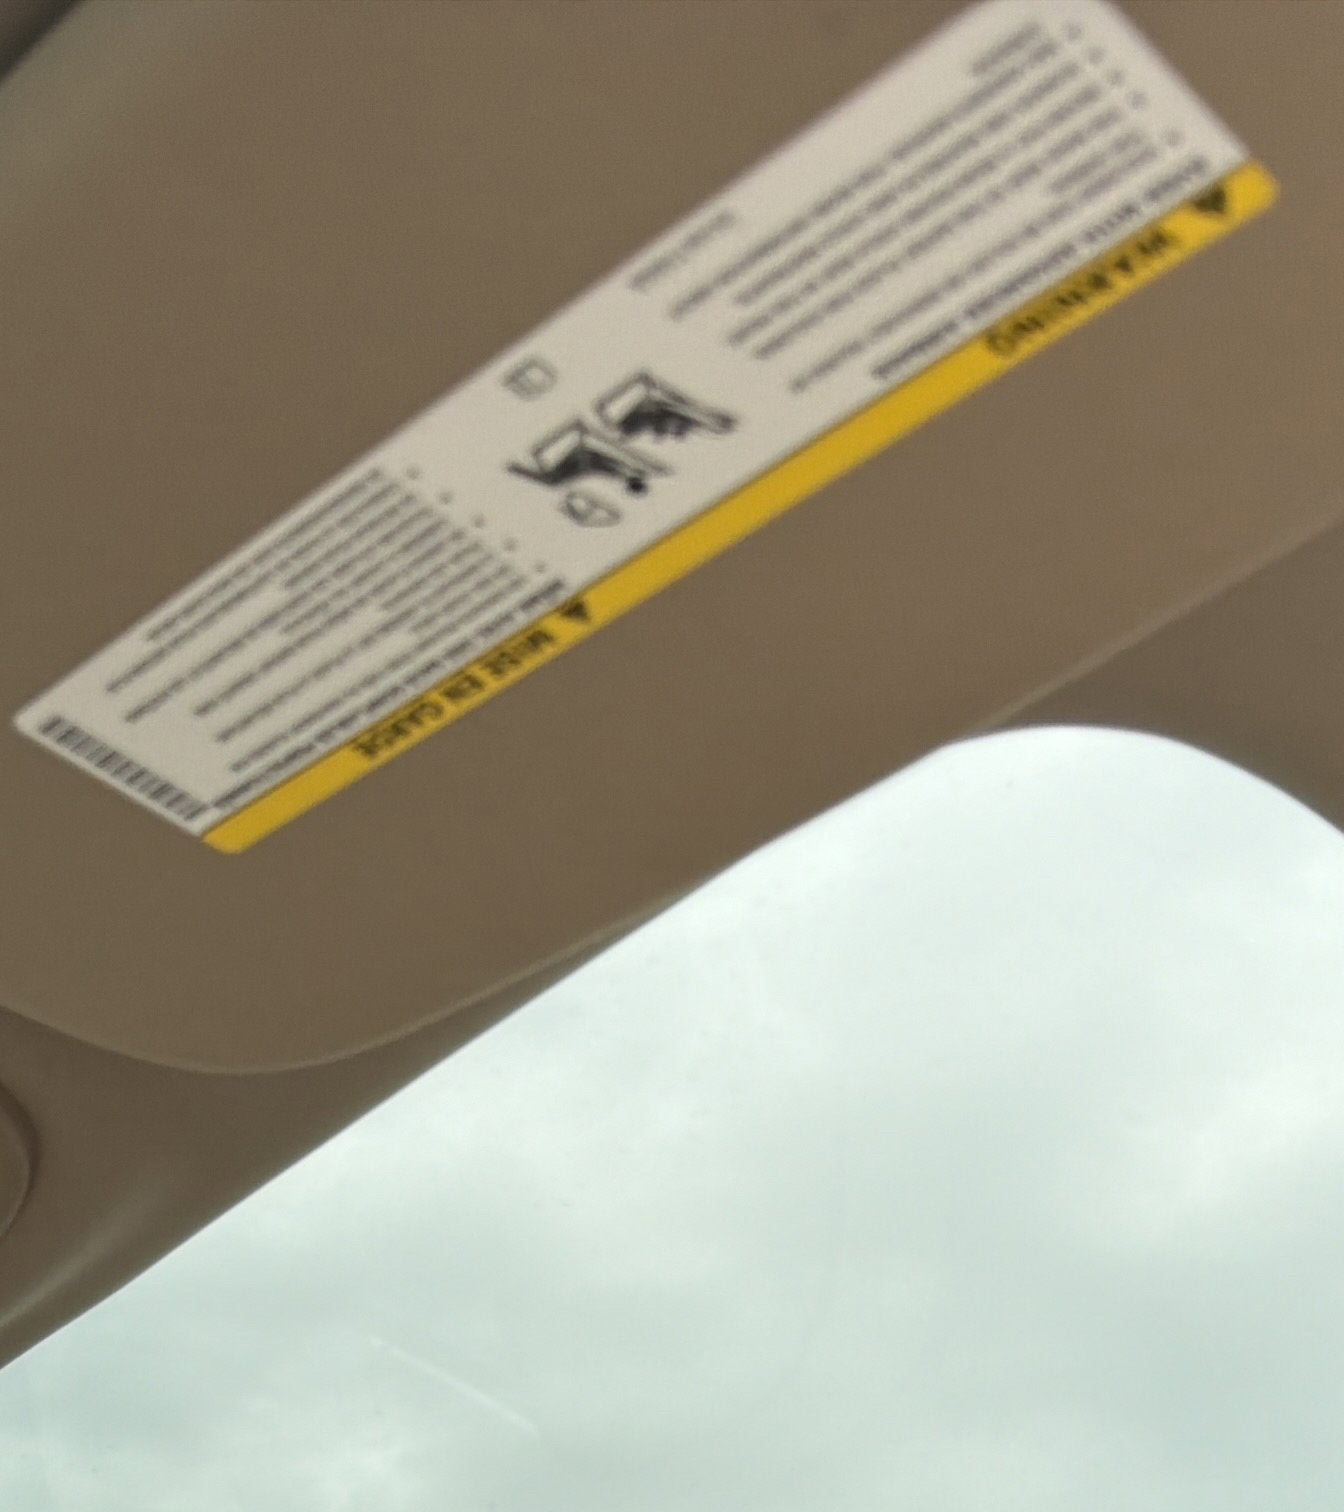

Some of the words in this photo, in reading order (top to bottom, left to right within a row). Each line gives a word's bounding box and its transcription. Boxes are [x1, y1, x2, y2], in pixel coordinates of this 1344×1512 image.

[975, 224, 1183, 359] WARNING
[479, 628, 560, 680] MISE
[438, 673, 489, 706] EN
[350, 697, 449, 761] GARDE
